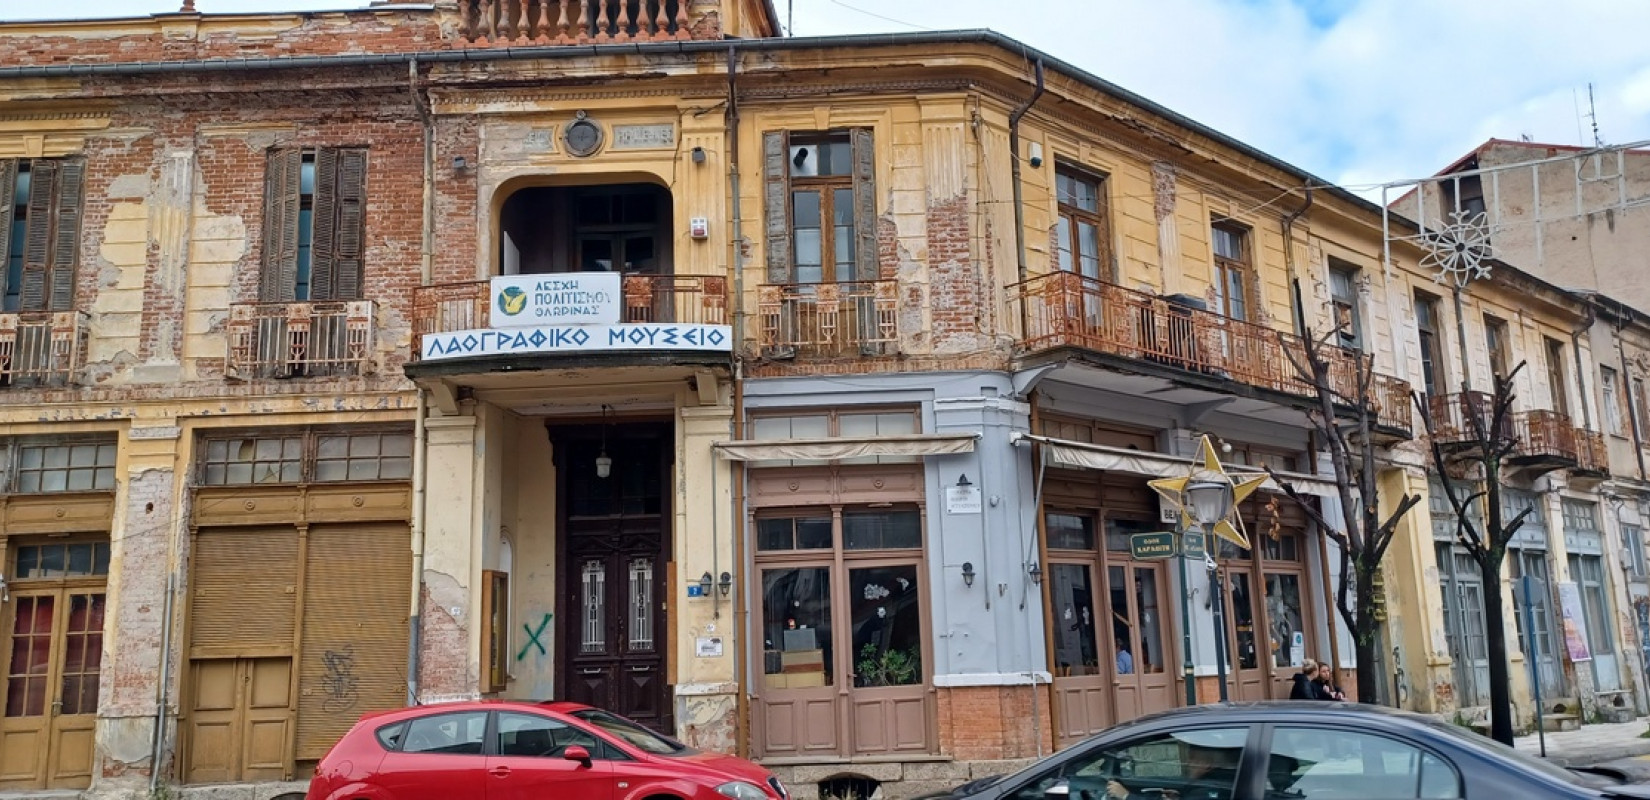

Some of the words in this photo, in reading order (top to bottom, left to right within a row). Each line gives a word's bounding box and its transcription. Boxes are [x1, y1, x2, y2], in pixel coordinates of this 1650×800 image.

[535, 280, 579, 291] ΛΕΣΧΗ
[427, 328, 590, 357] ΛΑΟΓΡΑΦΙΚΟ
[608, 327, 725, 347] ΜΟΥΣΕΙΟ
